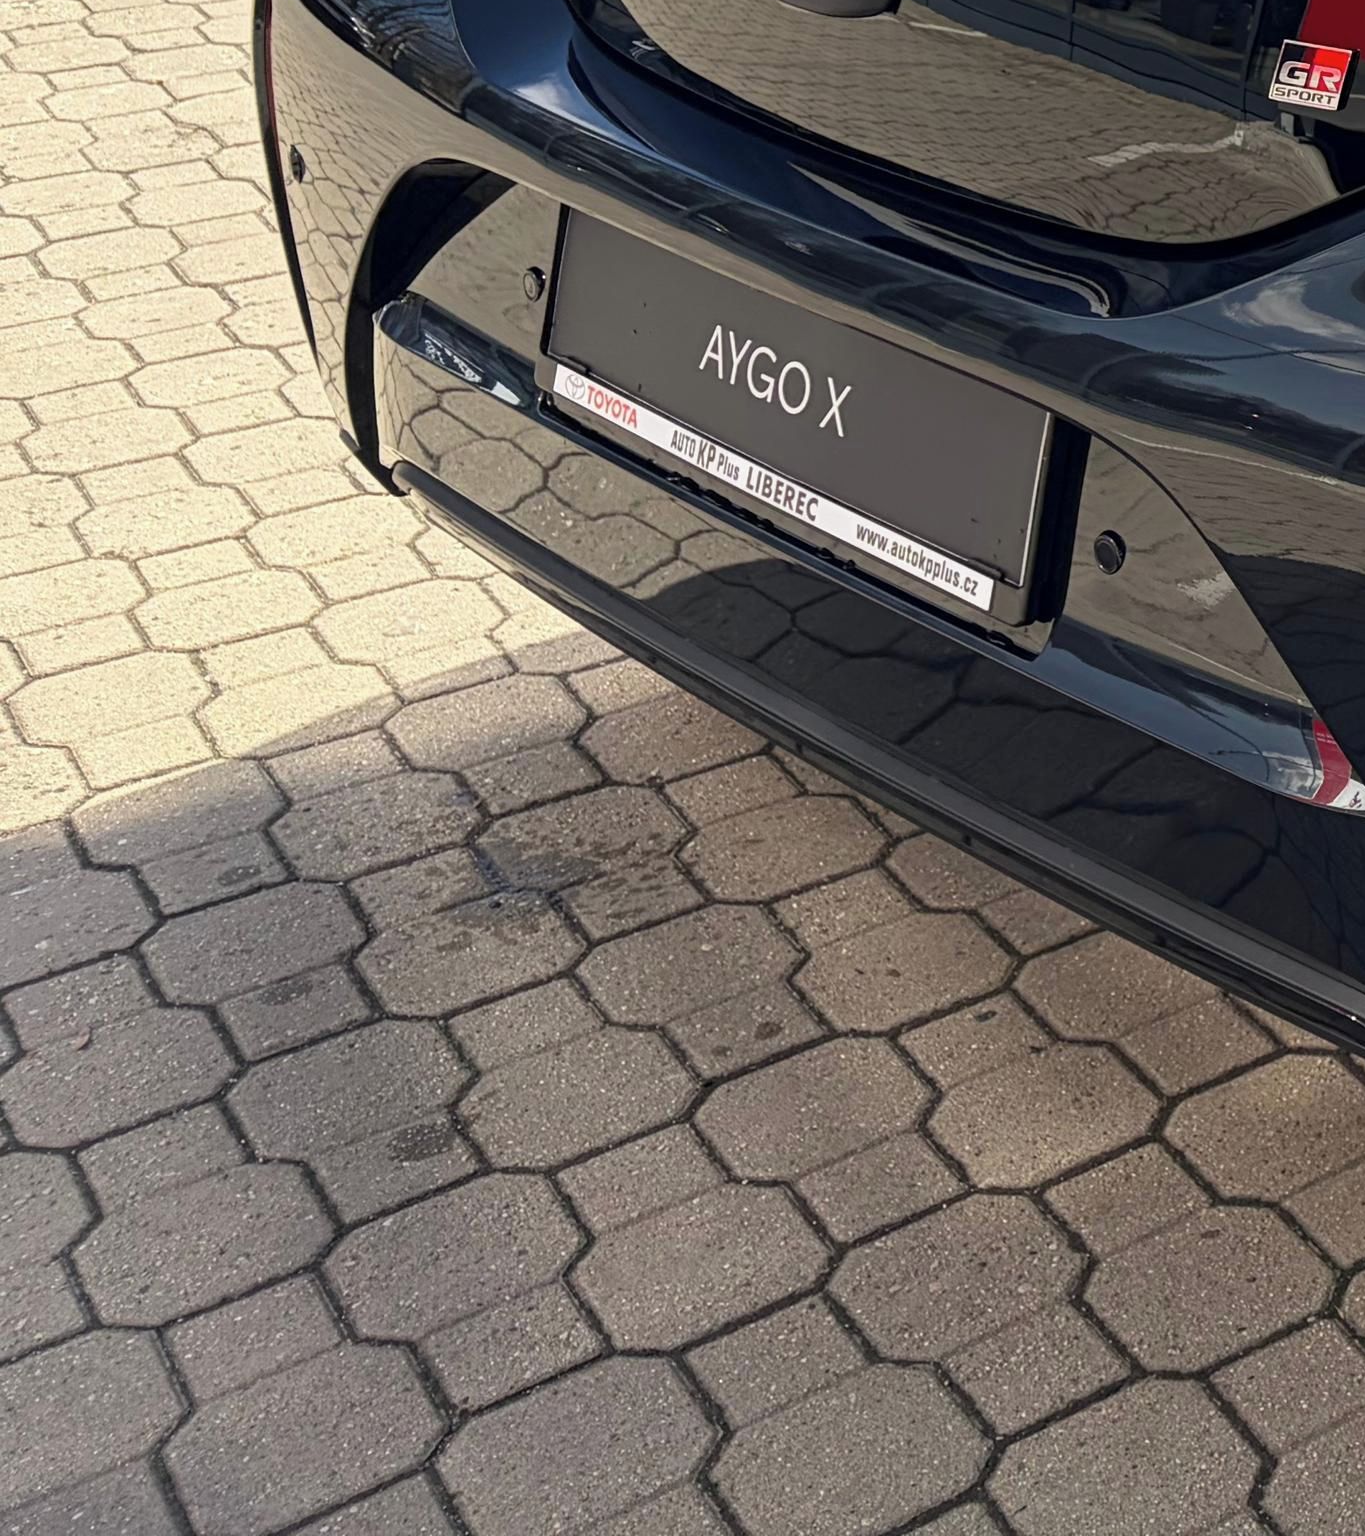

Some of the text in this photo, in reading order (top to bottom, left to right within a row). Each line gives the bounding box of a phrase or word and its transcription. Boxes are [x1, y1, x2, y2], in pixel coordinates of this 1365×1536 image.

[1274, 86, 1337, 105] SPORT
[1278, 60, 1342, 93] GR
[698, 324, 852, 438] AYGO X
[587, 385, 979, 596] TOYOTA AUTO KP Plus LIBEREC www.autokpplus.cz
